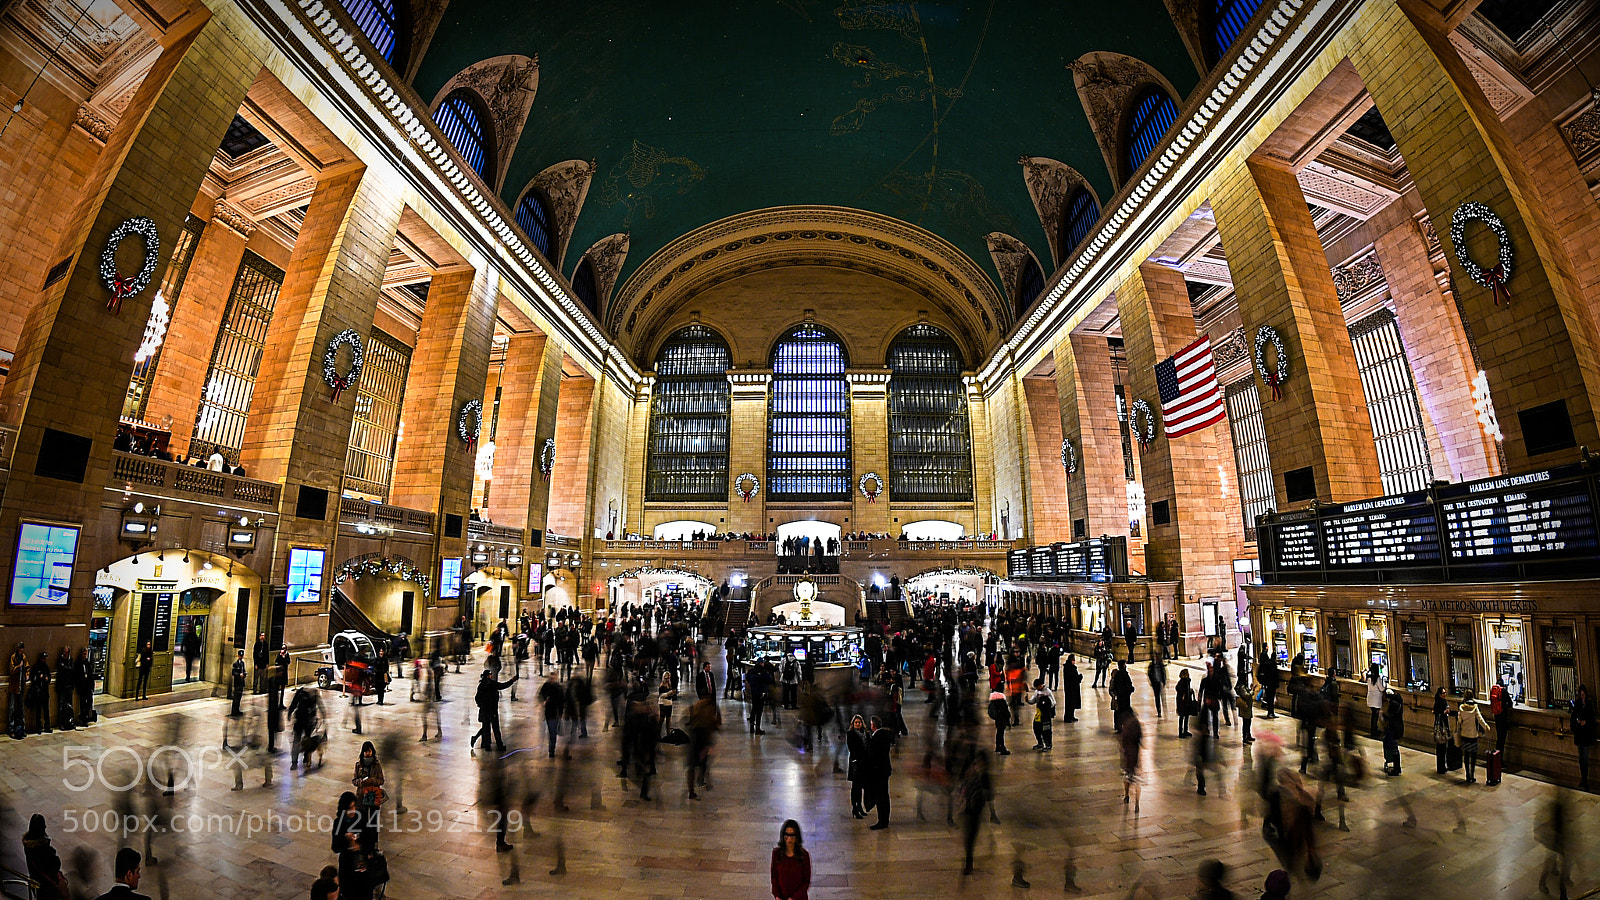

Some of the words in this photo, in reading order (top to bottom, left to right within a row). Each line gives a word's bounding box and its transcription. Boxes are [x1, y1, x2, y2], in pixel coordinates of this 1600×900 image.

[1470, 482, 1495, 492] HARLEM
[1496, 479, 1510, 488] LINE
[1510, 471, 1550, 486] DEPARTURES
[1468, 497, 1498, 507] DESTINATION
[1504, 493, 1527, 502] REMARKS
[1421, 600, 1438, 610] MTA
[1439, 600, 1500, 611] METRO-NORTH
[1501, 600, 1538, 611] TICKETS
